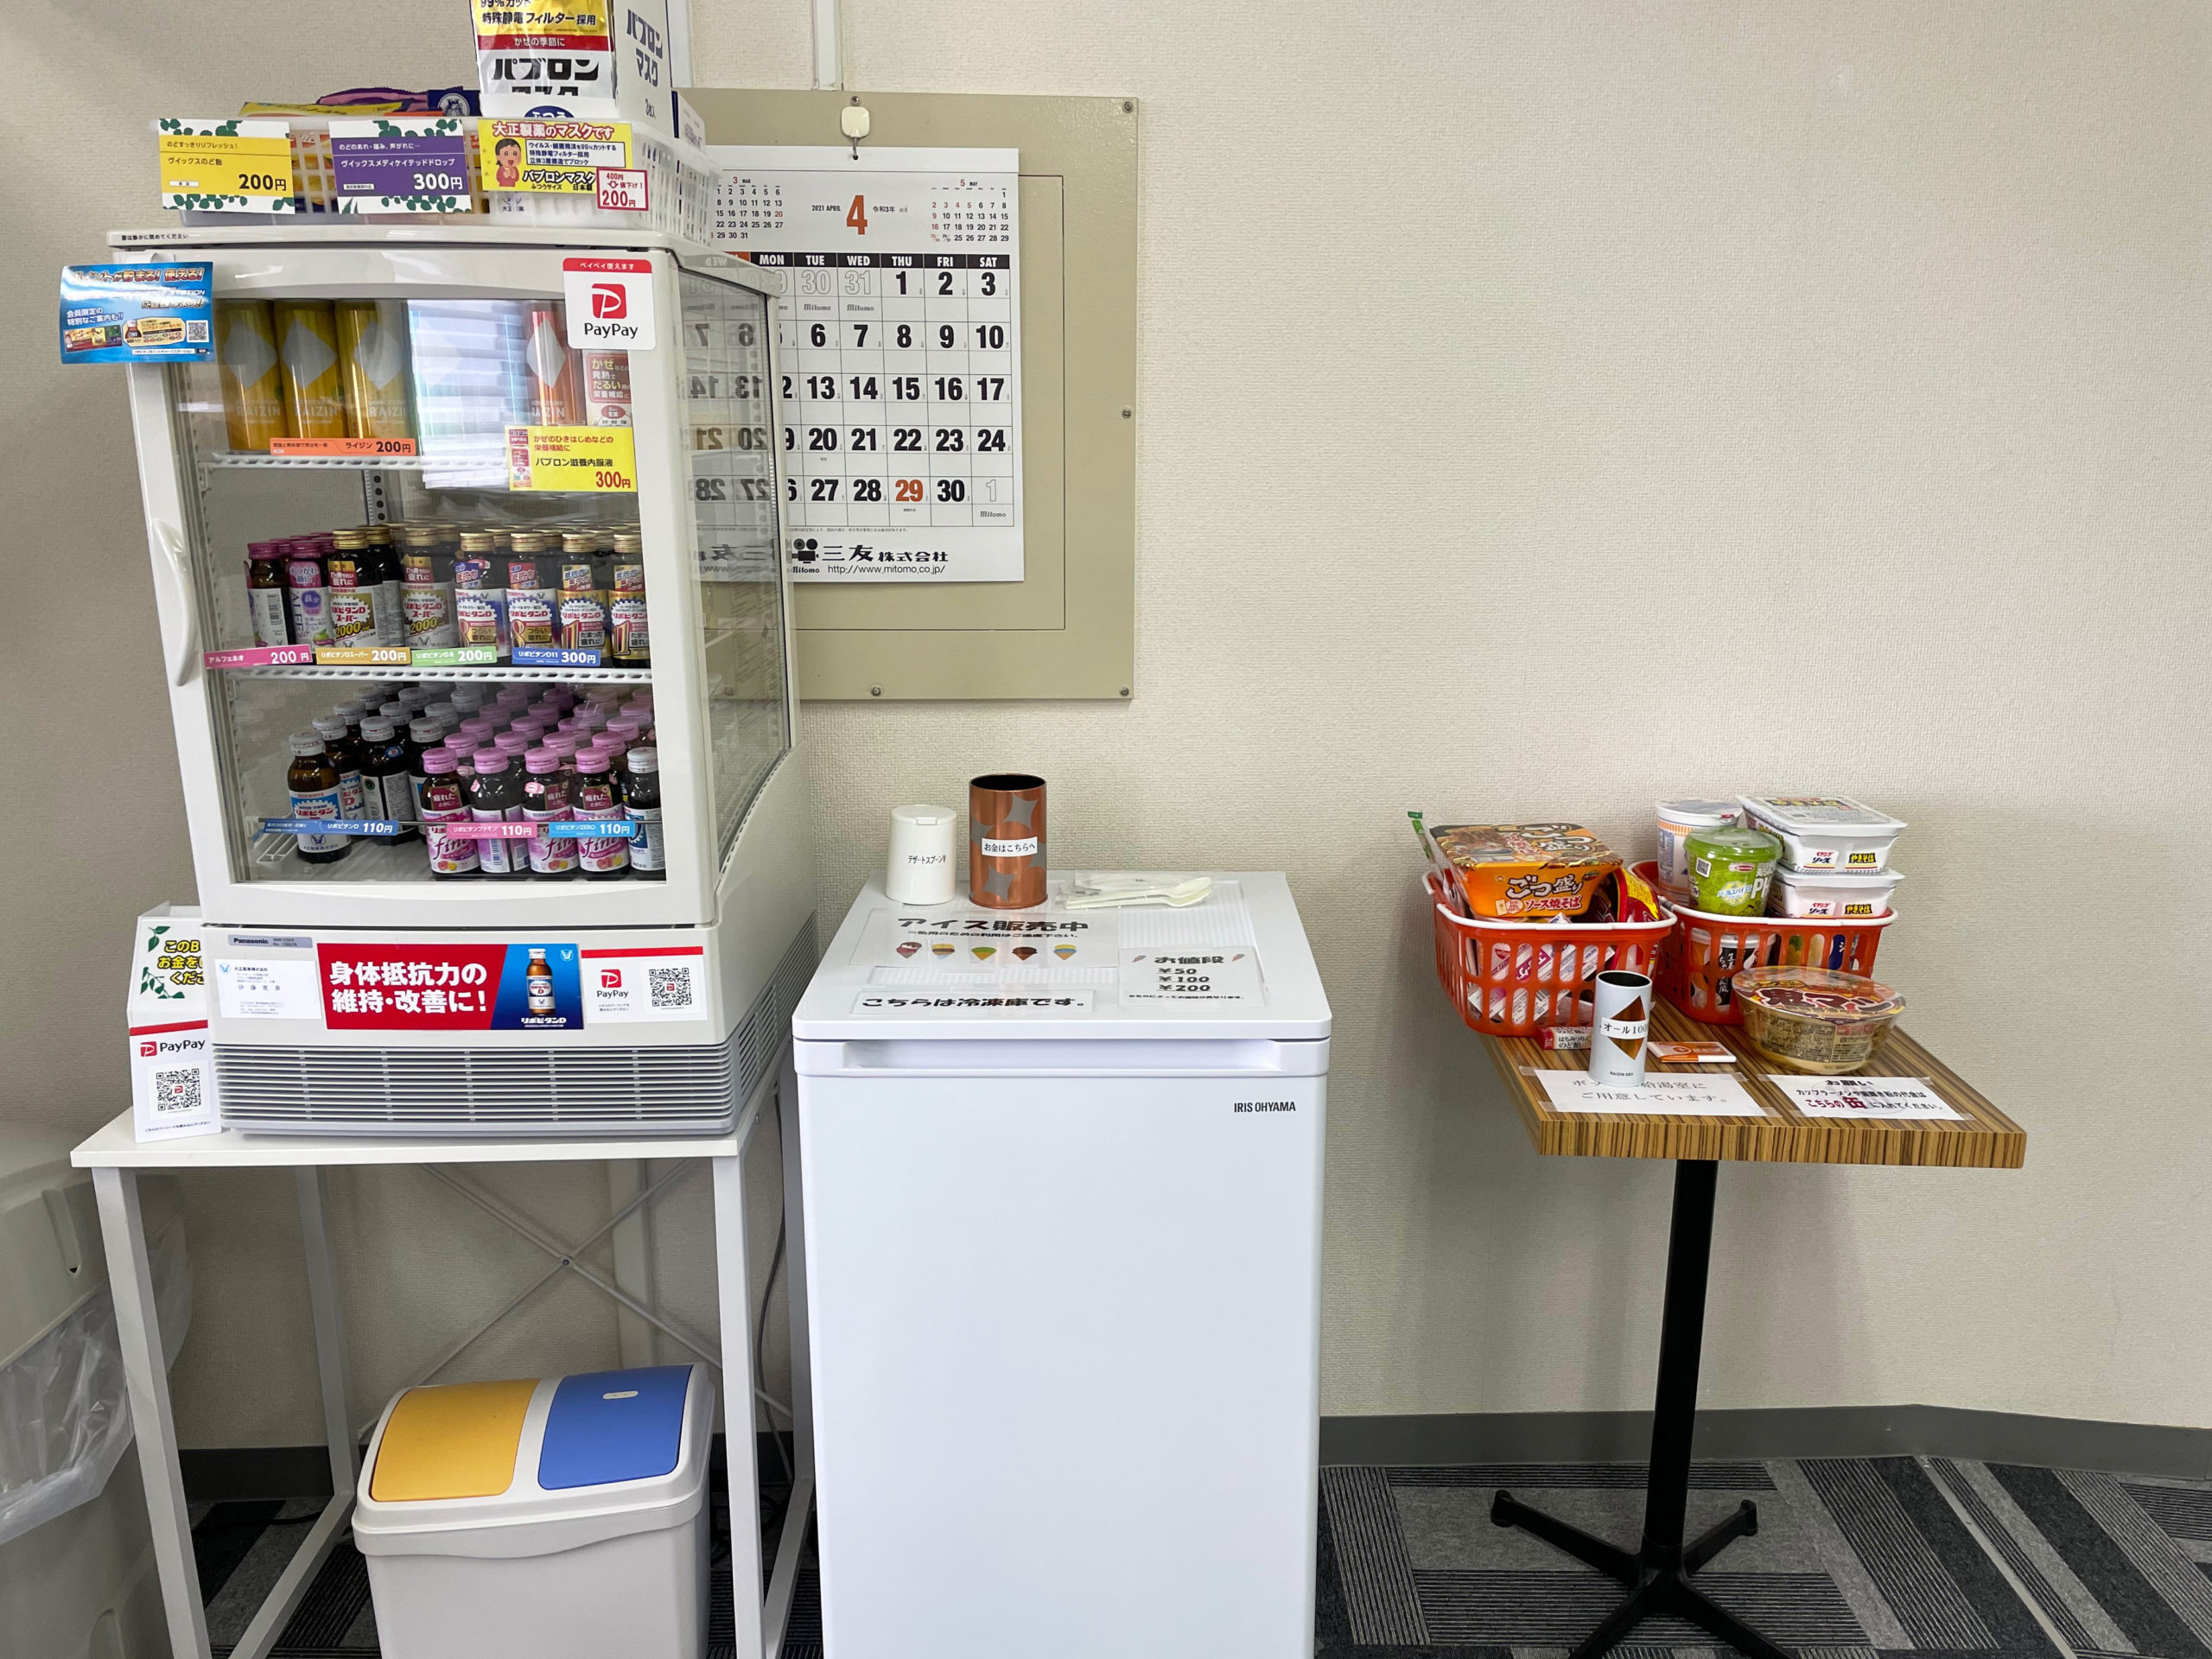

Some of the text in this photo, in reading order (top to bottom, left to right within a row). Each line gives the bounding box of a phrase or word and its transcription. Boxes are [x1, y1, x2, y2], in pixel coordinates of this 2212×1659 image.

[626, 9, 663, 60] パブロン
[492, 57, 600, 82] パブロン
[635, 48, 658, 87] マスク
[493, 120, 615, 140] 大正製薬のマスクです
[238, 174, 288, 192] 200円
[413, 172, 463, 190] 300円
[522, 169, 596, 185] パブロンマスク
[602, 190, 636, 207] 200円
[846, 194, 868, 236] 4
[580, 261, 635, 271] ペイペイ使えます
[760, 255, 997, 267] MON TUE WED THU FRI SAT
[895, 270, 907, 296] 1
[938, 271, 953, 296] 2
[981, 271, 996, 296] 3
[584, 321, 639, 340] PayPay
[810, 323, 1004, 349] 6 7 8 9 10
[806, 375, 1005, 401] 13 14 15 16 17
[533, 435, 613, 443] かぜのひきはじめなどの
[808, 427, 1006, 452] 20 21 22 23 24
[376, 441, 411, 454] 200円
[535, 458, 613, 467] パブロン滋養内服液
[595, 471, 632, 488] 300円
[810, 478, 839, 502] 27
[853, 479, 882, 502] 28
[894, 479, 924, 502] 29
[937, 479, 965, 503] 30
[827, 564, 947, 575] http://www.mitomo.co.jp/
[207, 653, 245, 664] アルフェネオ
[372, 650, 407, 663] 200円
[458, 650, 493, 662] 200円
[561, 652, 596, 664] 300円
[363, 822, 392, 833] 110円
[501, 825, 532, 836] 110円
[599, 823, 630, 836] 110円
[983, 842, 1037, 854] お金はこちらへ
[1848, 853, 1876, 863] やきそば
[1505, 874, 1584, 899] ごつ盛り
[1524, 894, 1583, 912] ソース焼そば
[1844, 904, 1873, 914] やきそば
[898, 918, 1089, 932] アイス販売中
[1154, 956, 1224, 965] お値段
[329, 960, 488, 988] 身体抵抗力の
[596, 990, 629, 999] PayPay
[861, 995, 1086, 1009] こちらは冷凍庫です。
[159, 1039, 207, 1053] PayPay
[1580, 1091, 1728, 1103] ご用意しています。
[1234, 1101, 1296, 1113] IRIS OHYAMA
